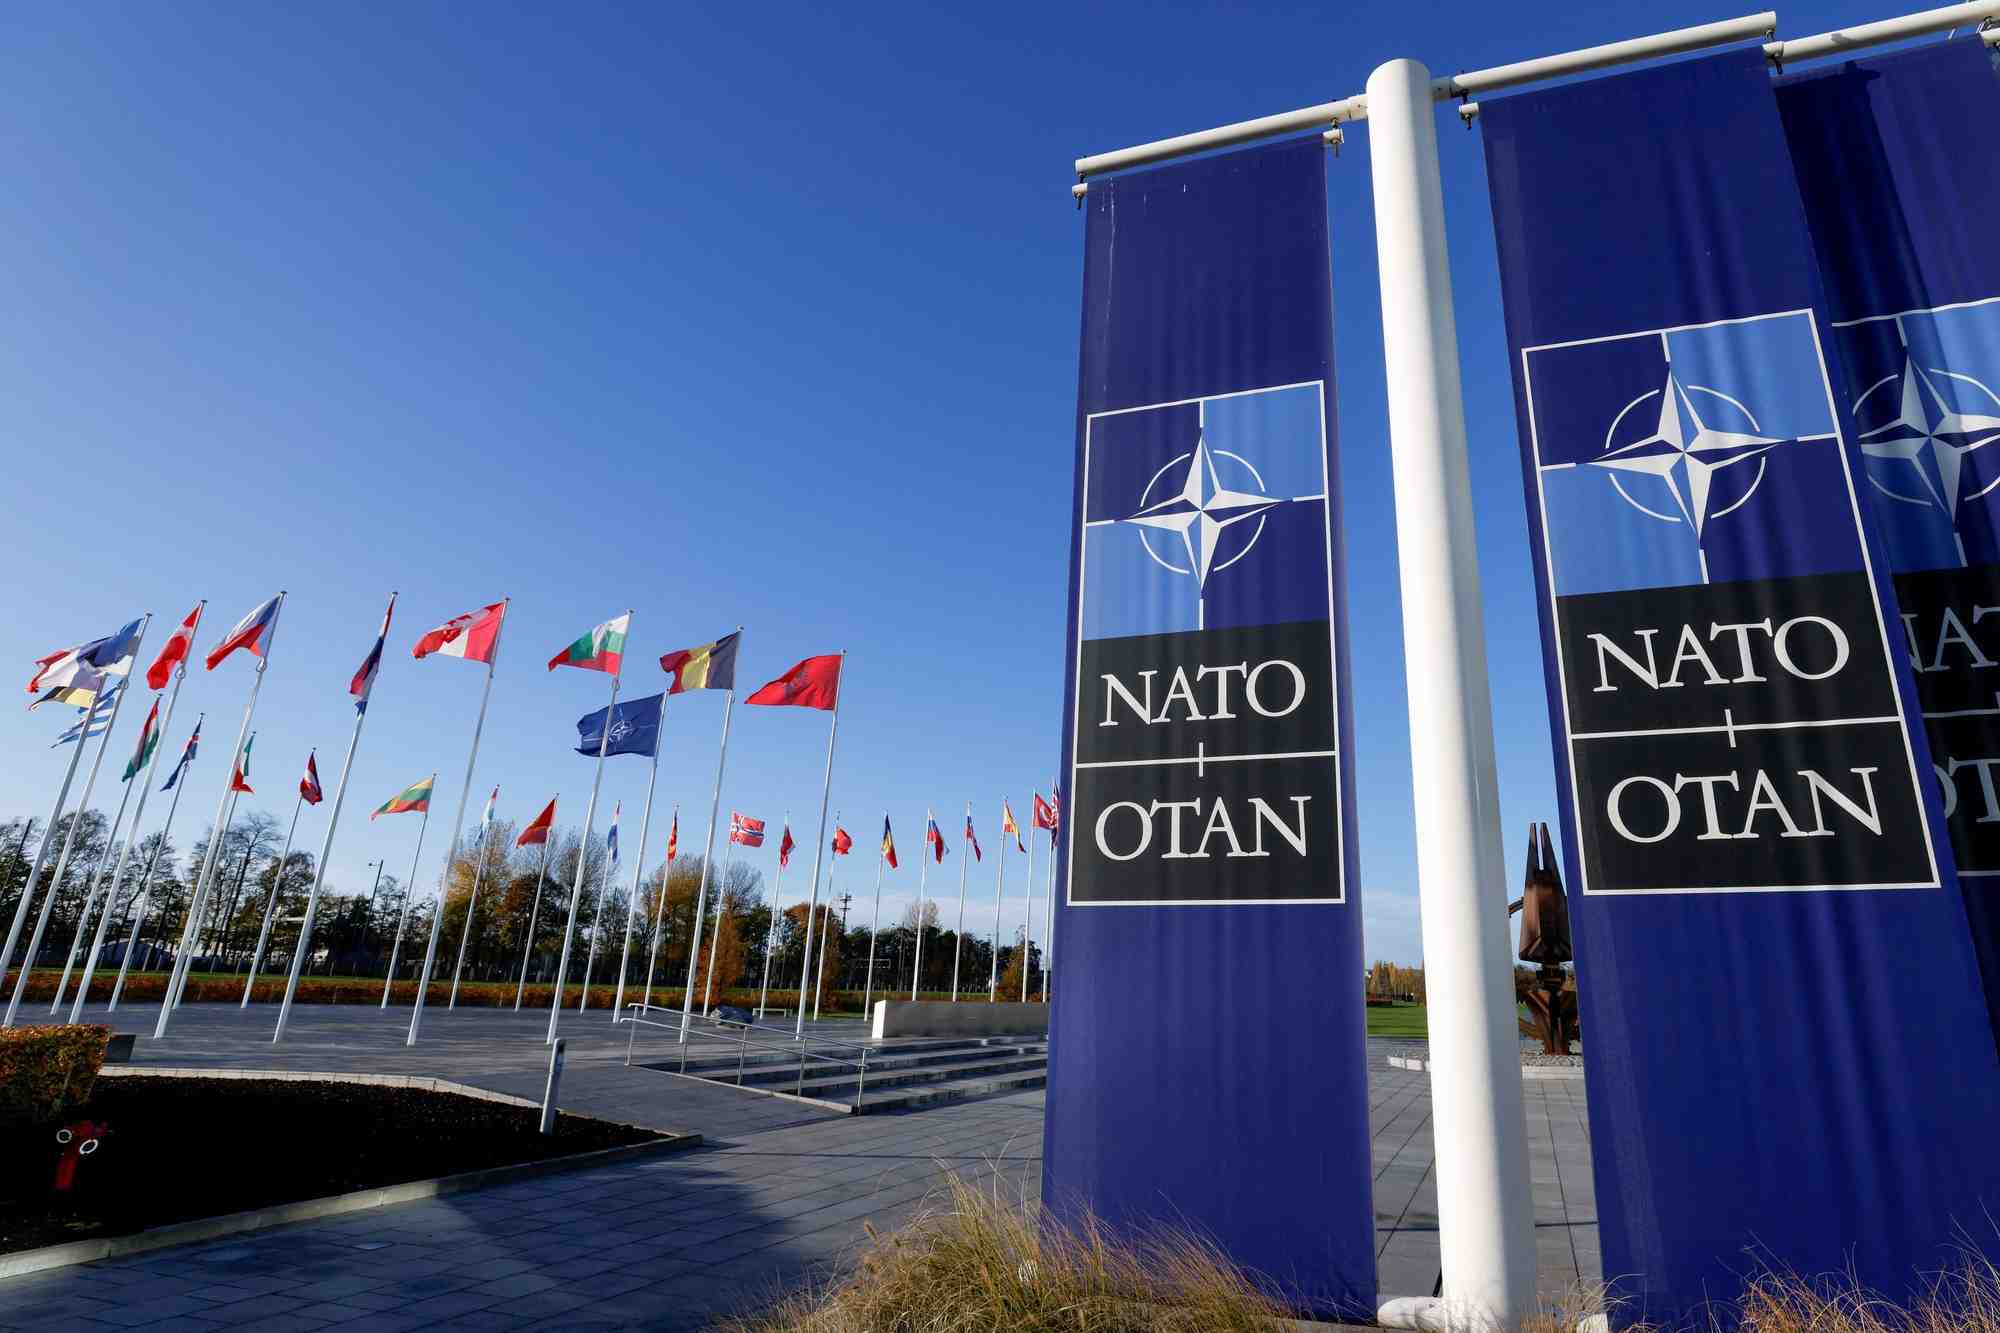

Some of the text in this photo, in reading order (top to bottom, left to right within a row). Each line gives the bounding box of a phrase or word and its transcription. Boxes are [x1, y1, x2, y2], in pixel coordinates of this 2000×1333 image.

[1587, 615, 1849, 692] NATO
[1098, 659, 1306, 726] NATO
[1094, 795, 1312, 861] OTAN
[1606, 766, 1883, 843] OTAN
